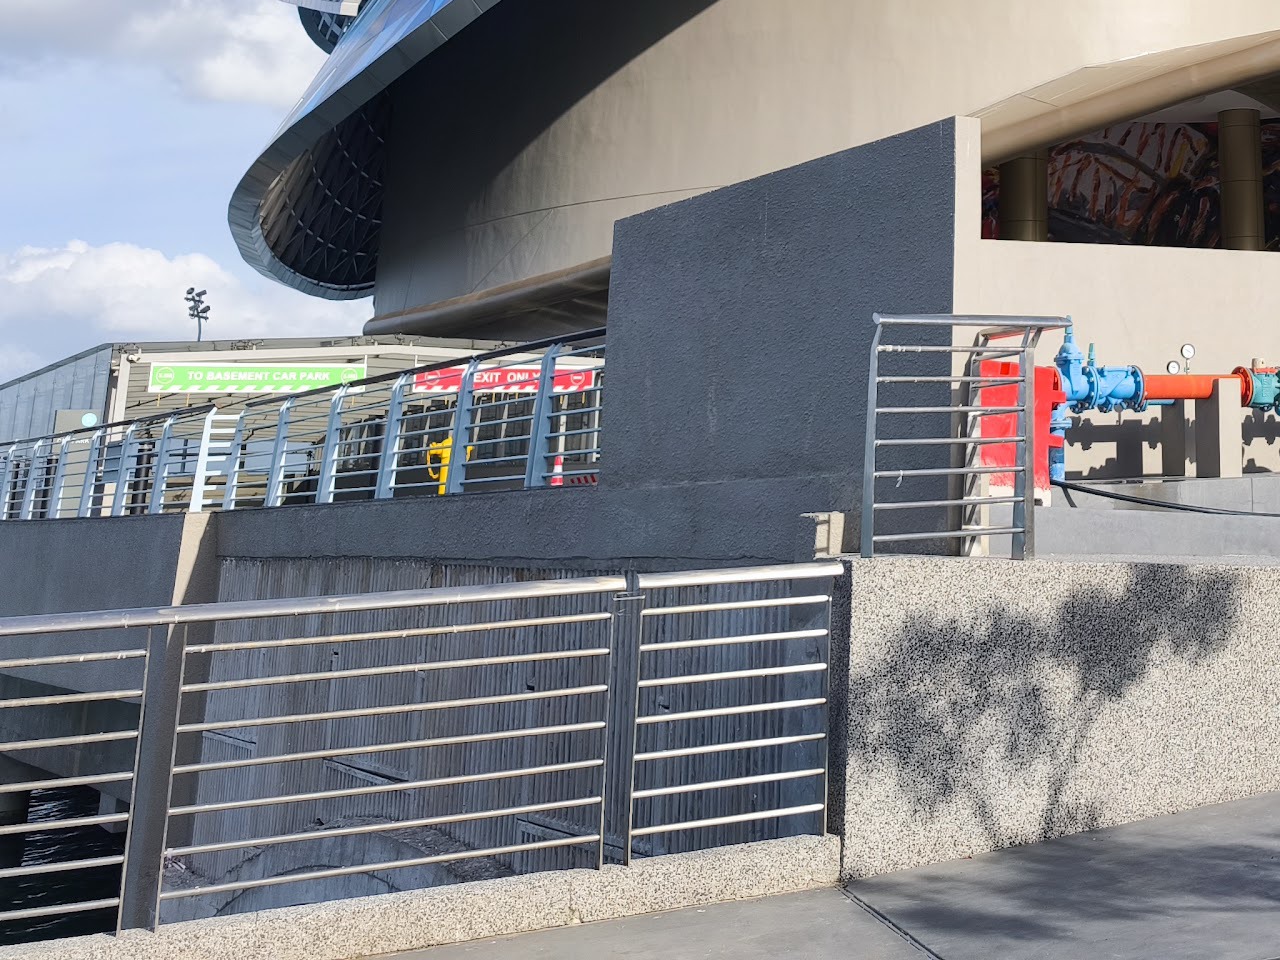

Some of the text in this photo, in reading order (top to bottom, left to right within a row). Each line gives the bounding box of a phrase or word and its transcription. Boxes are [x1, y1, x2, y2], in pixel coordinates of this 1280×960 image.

[187, 371, 330, 381] TO BASEMENT CAR PARK
[474, 371, 502, 383] EXIT
